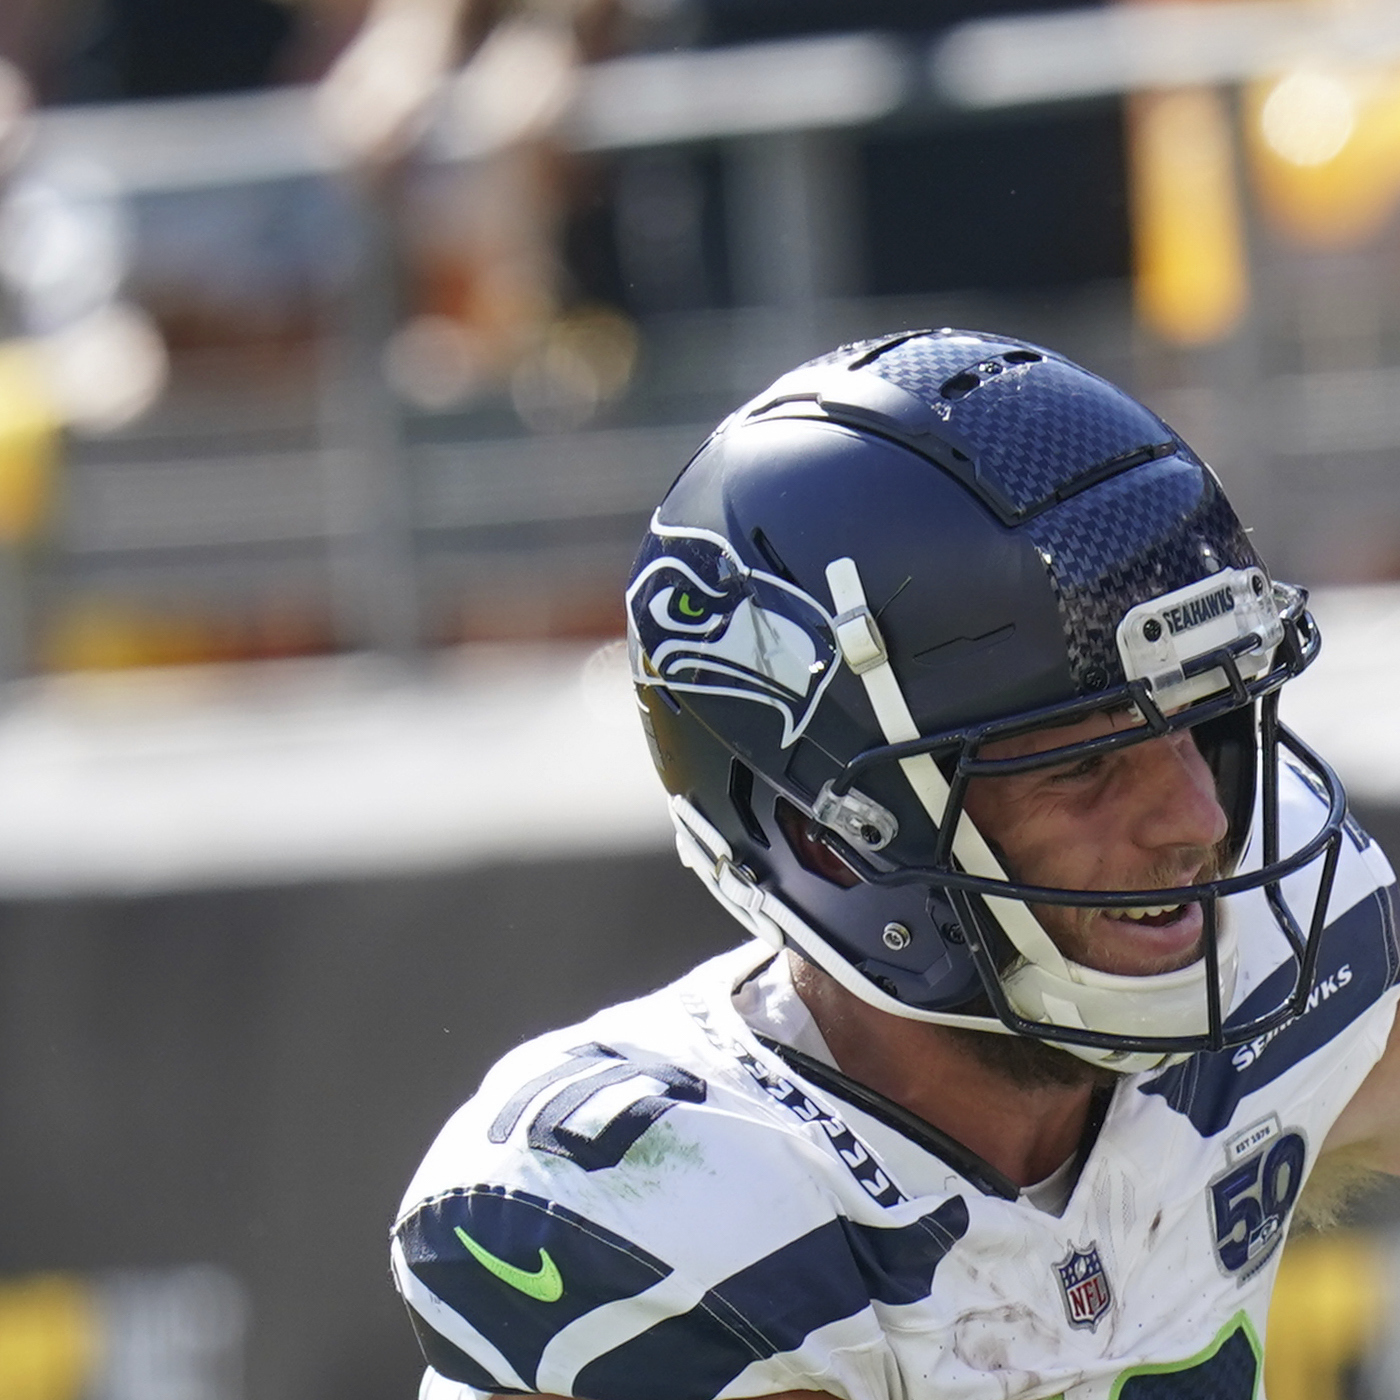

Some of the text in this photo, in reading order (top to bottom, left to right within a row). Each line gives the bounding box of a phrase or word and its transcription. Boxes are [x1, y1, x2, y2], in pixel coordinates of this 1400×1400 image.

[1162, 586, 1235, 635] SEAHAWKS
[487, 1041, 708, 1172] 10
[1236, 1137, 1251, 1154] EST
[1211, 1133, 1306, 1271] 50
[1069, 1277, 1107, 1317] NFL
